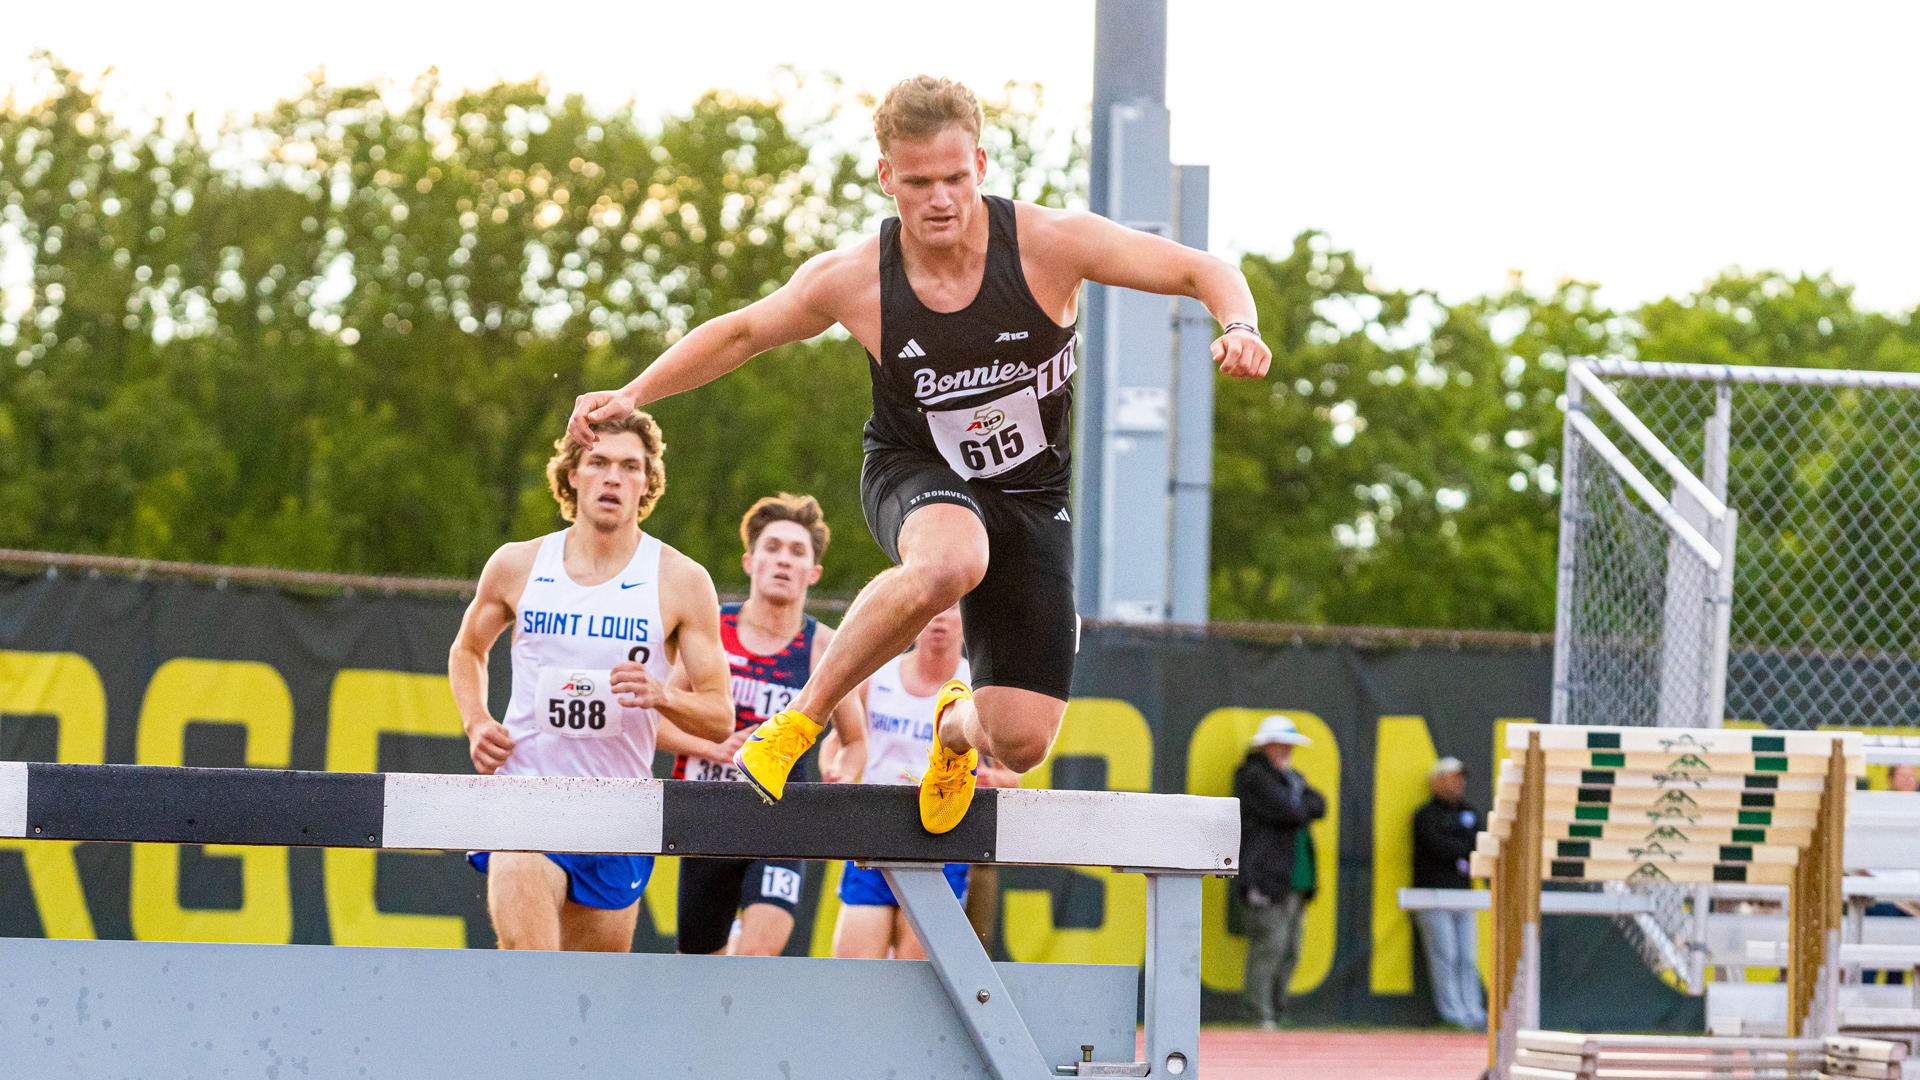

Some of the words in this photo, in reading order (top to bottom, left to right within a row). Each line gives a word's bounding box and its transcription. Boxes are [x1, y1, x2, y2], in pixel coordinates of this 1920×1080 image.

[995, 331, 1029, 343] A10
[914, 360, 1037, 399] Bonnies
[1041, 345, 1071, 393] 10
[959, 423, 1024, 471] 615
[524, 611, 582, 636] SAINT
[588, 615, 648, 642] LOUIS
[549, 698, 606, 730] 588
[767, 871, 793, 896] 13
